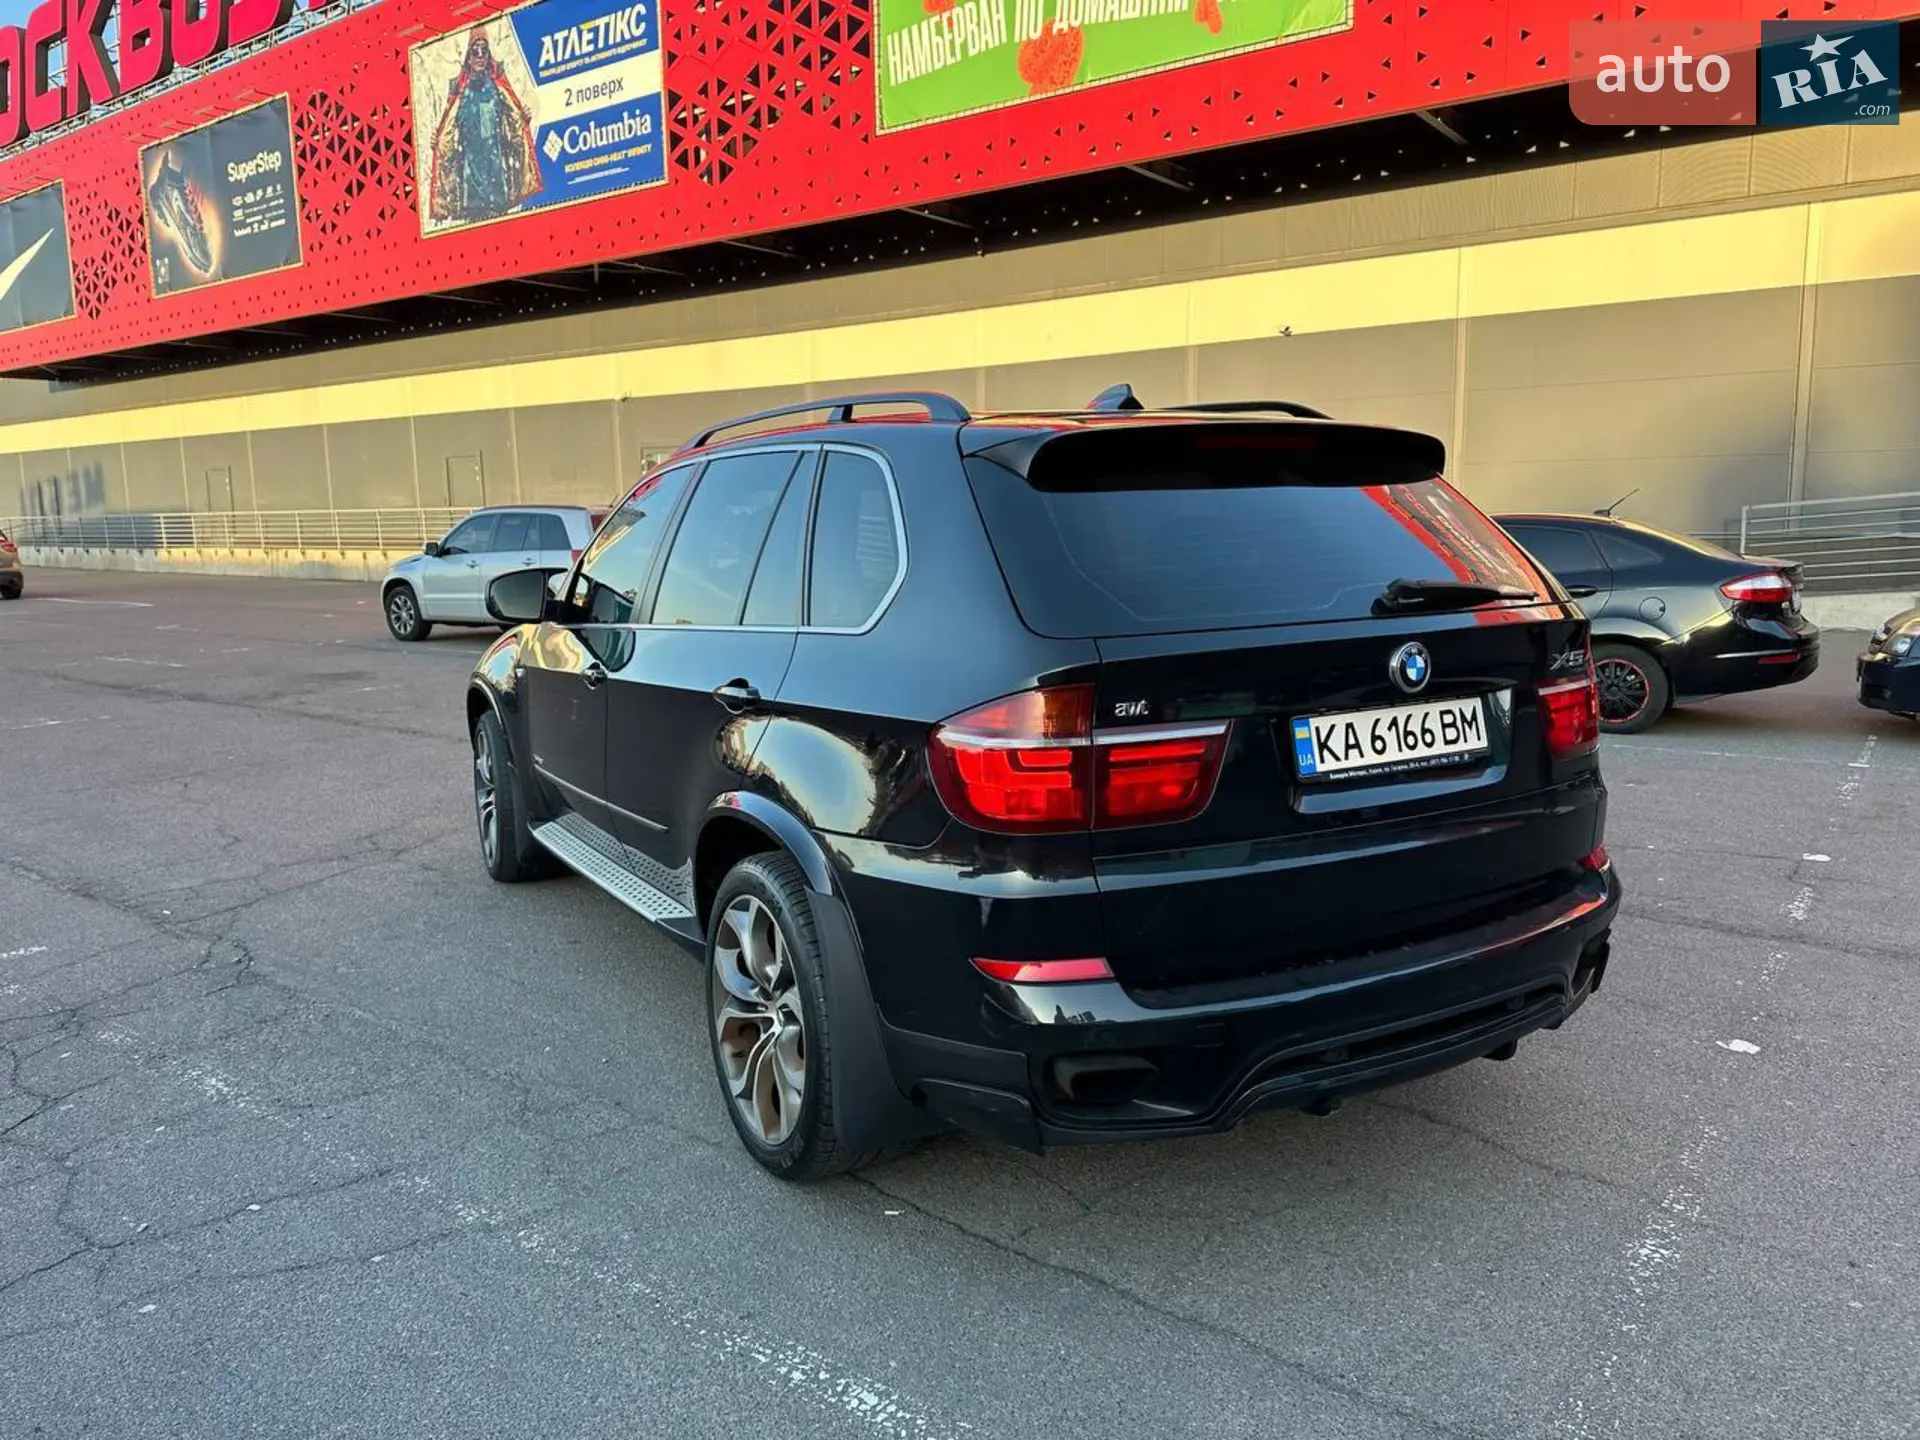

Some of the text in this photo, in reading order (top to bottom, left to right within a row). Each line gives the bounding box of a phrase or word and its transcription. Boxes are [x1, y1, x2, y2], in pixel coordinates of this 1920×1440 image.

[539, 3, 647, 68] АТЛЕТІКС
[887, 0, 1007, 86] НАМБЕРВАН
[1014, 0, 1044, 42] ПО
[564, 77, 624, 107] 2 поверх
[563, 109, 652, 154] Columbia
[227, 150, 282, 183] SuperStep
[1550, 650, 1585, 670] X5
[1315, 705, 1482, 764] KA 6166 BM
[1299, 754, 1314, 766] UA
